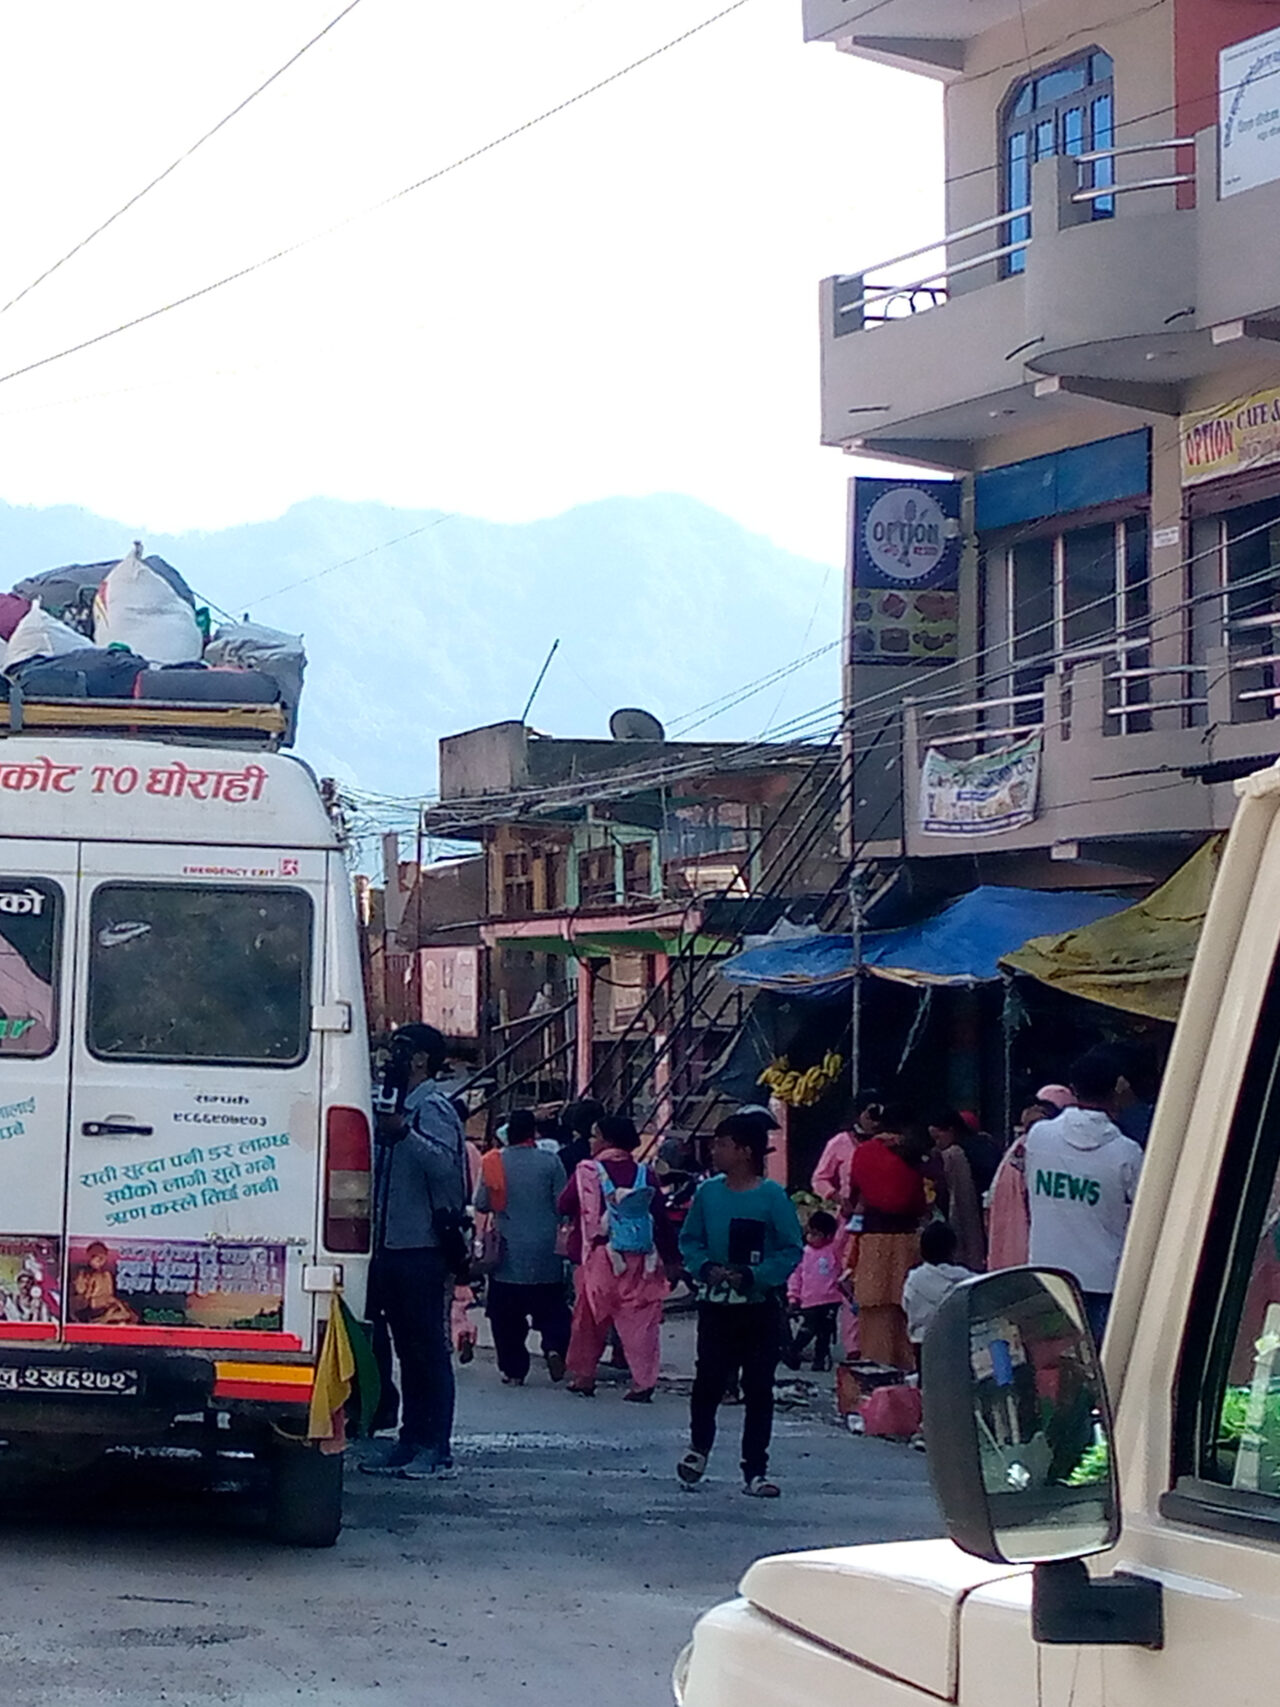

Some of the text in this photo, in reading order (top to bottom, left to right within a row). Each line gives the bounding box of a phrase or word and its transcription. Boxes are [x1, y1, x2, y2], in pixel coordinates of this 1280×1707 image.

[1186, 420, 1234, 466] OPTION
[873, 521, 938, 543] OPTION
[90, 765, 138, 795] TO
[146, 761, 269, 803] घोराही
[182, 865, 276, 877] EMERGENCY EXIT
[1036, 1169, 1100, 1207] NEWS
